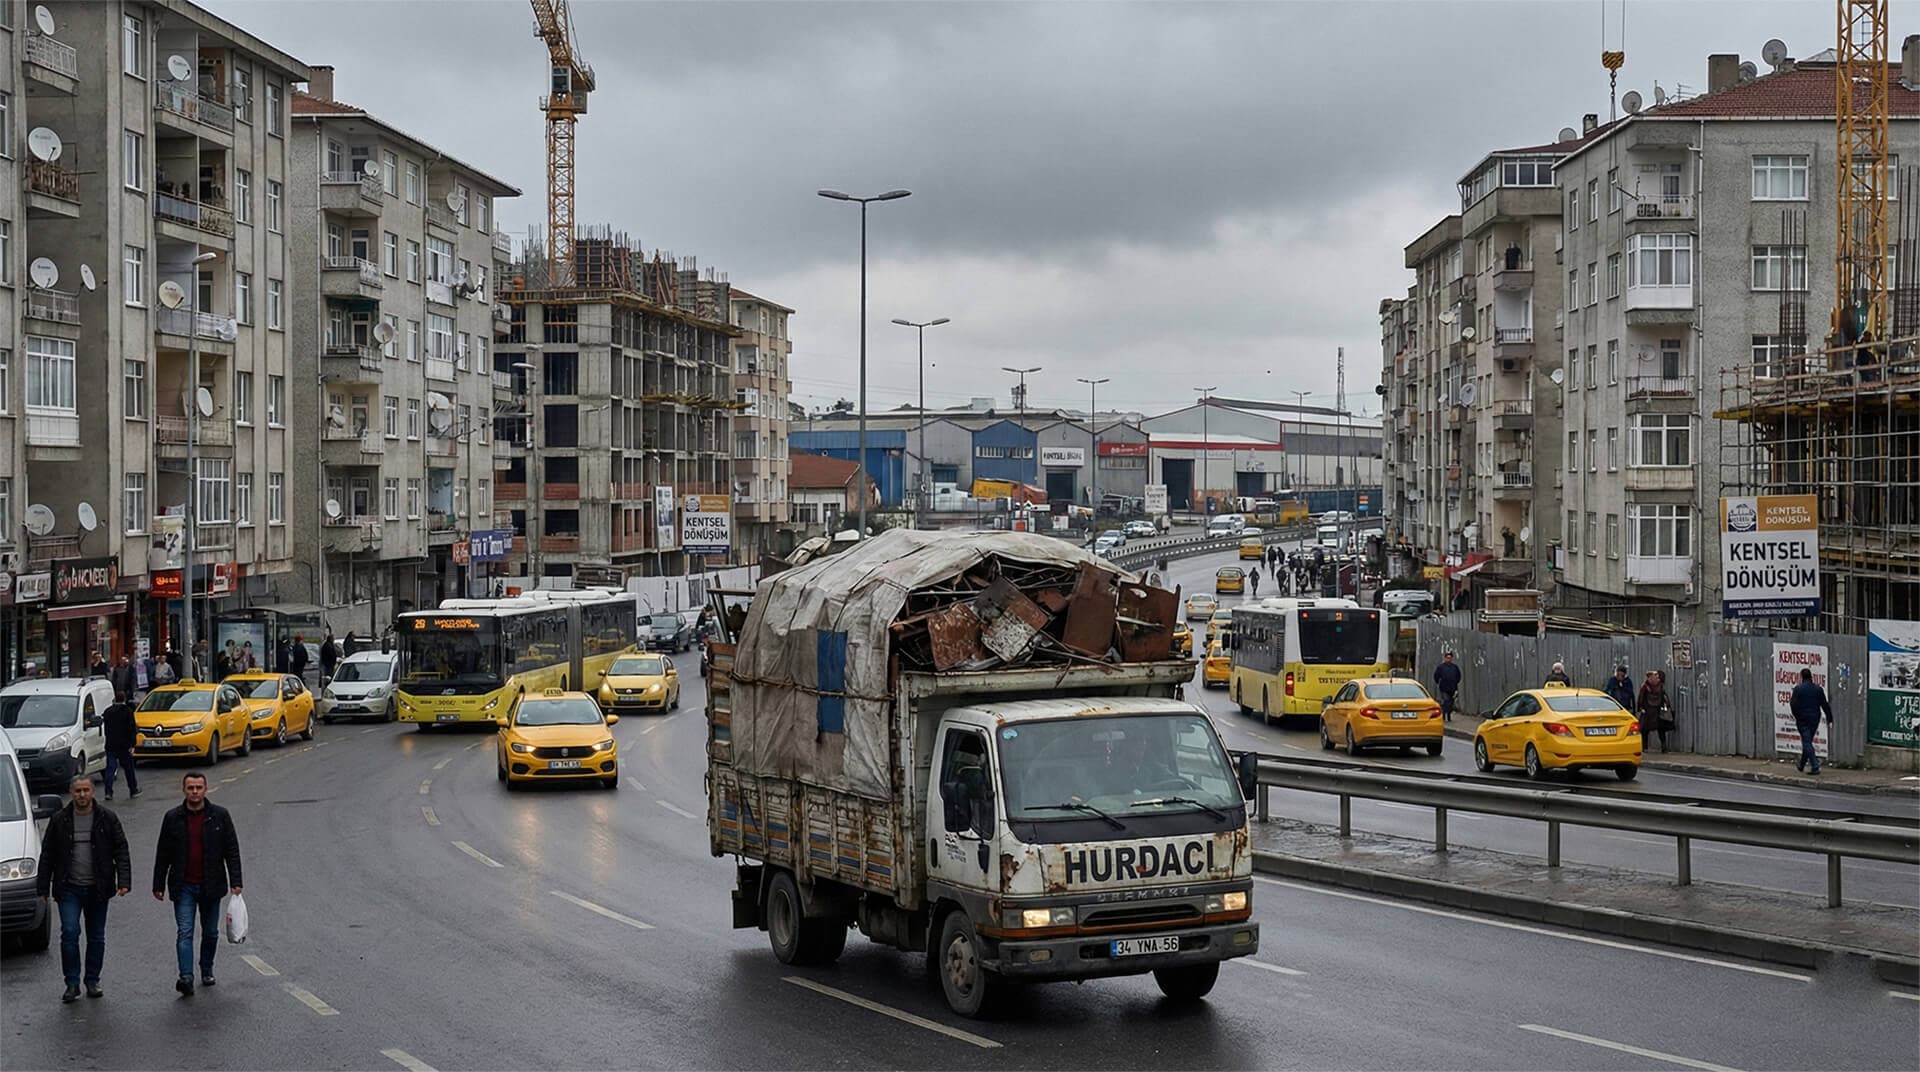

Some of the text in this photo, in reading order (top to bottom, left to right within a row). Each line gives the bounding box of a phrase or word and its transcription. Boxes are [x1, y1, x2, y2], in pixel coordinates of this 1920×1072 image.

[1767, 506, 1808, 515] KENTSEL
[686, 517, 726, 527] KENTSEL
[684, 528, 728, 542] DÖNÜŞÜM
[1730, 542, 1811, 561] KENTSEL
[1727, 564, 1816, 592] DÖNÜŞÜM
[1064, 840, 1214, 884] HURDACI
[1118, 941, 1132, 954] 34
[1163, 937, 1178, 951] 56
